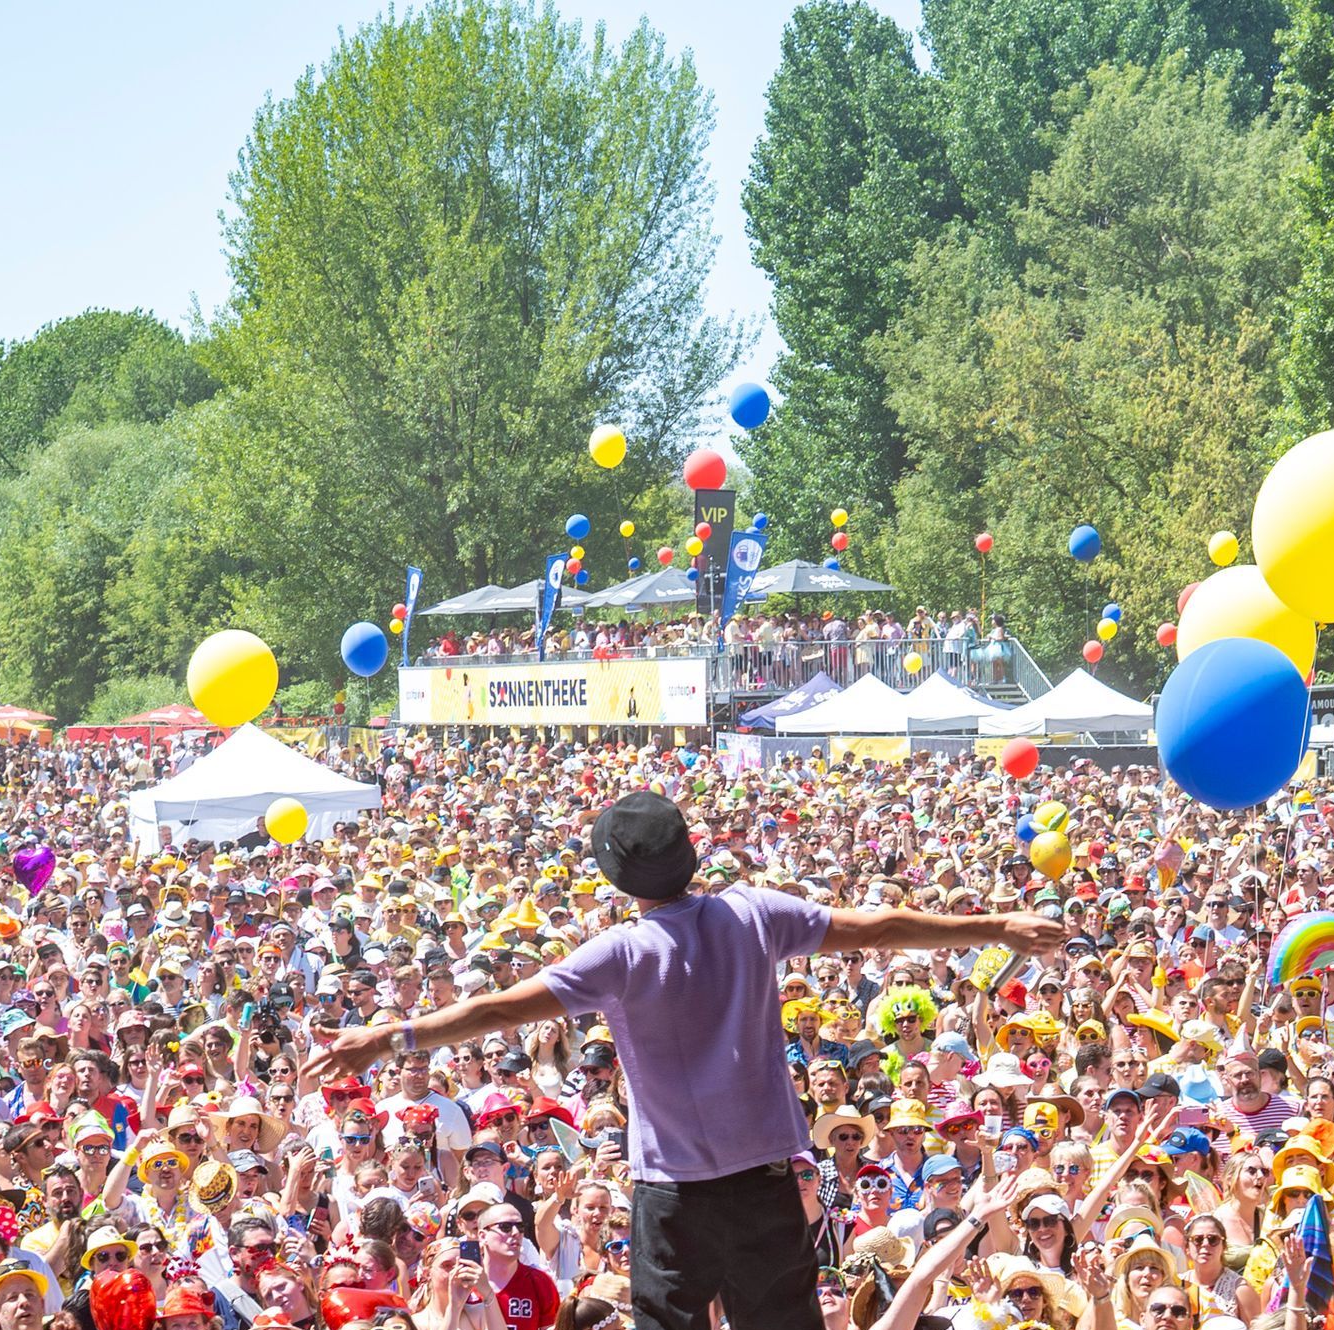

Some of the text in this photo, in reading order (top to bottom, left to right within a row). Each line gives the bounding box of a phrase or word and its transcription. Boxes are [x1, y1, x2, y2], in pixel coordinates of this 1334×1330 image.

[701, 507, 728, 523] VIP
[489, 679, 587, 708] SONNENTHEKE
[509, 1298, 533, 1318] 22
